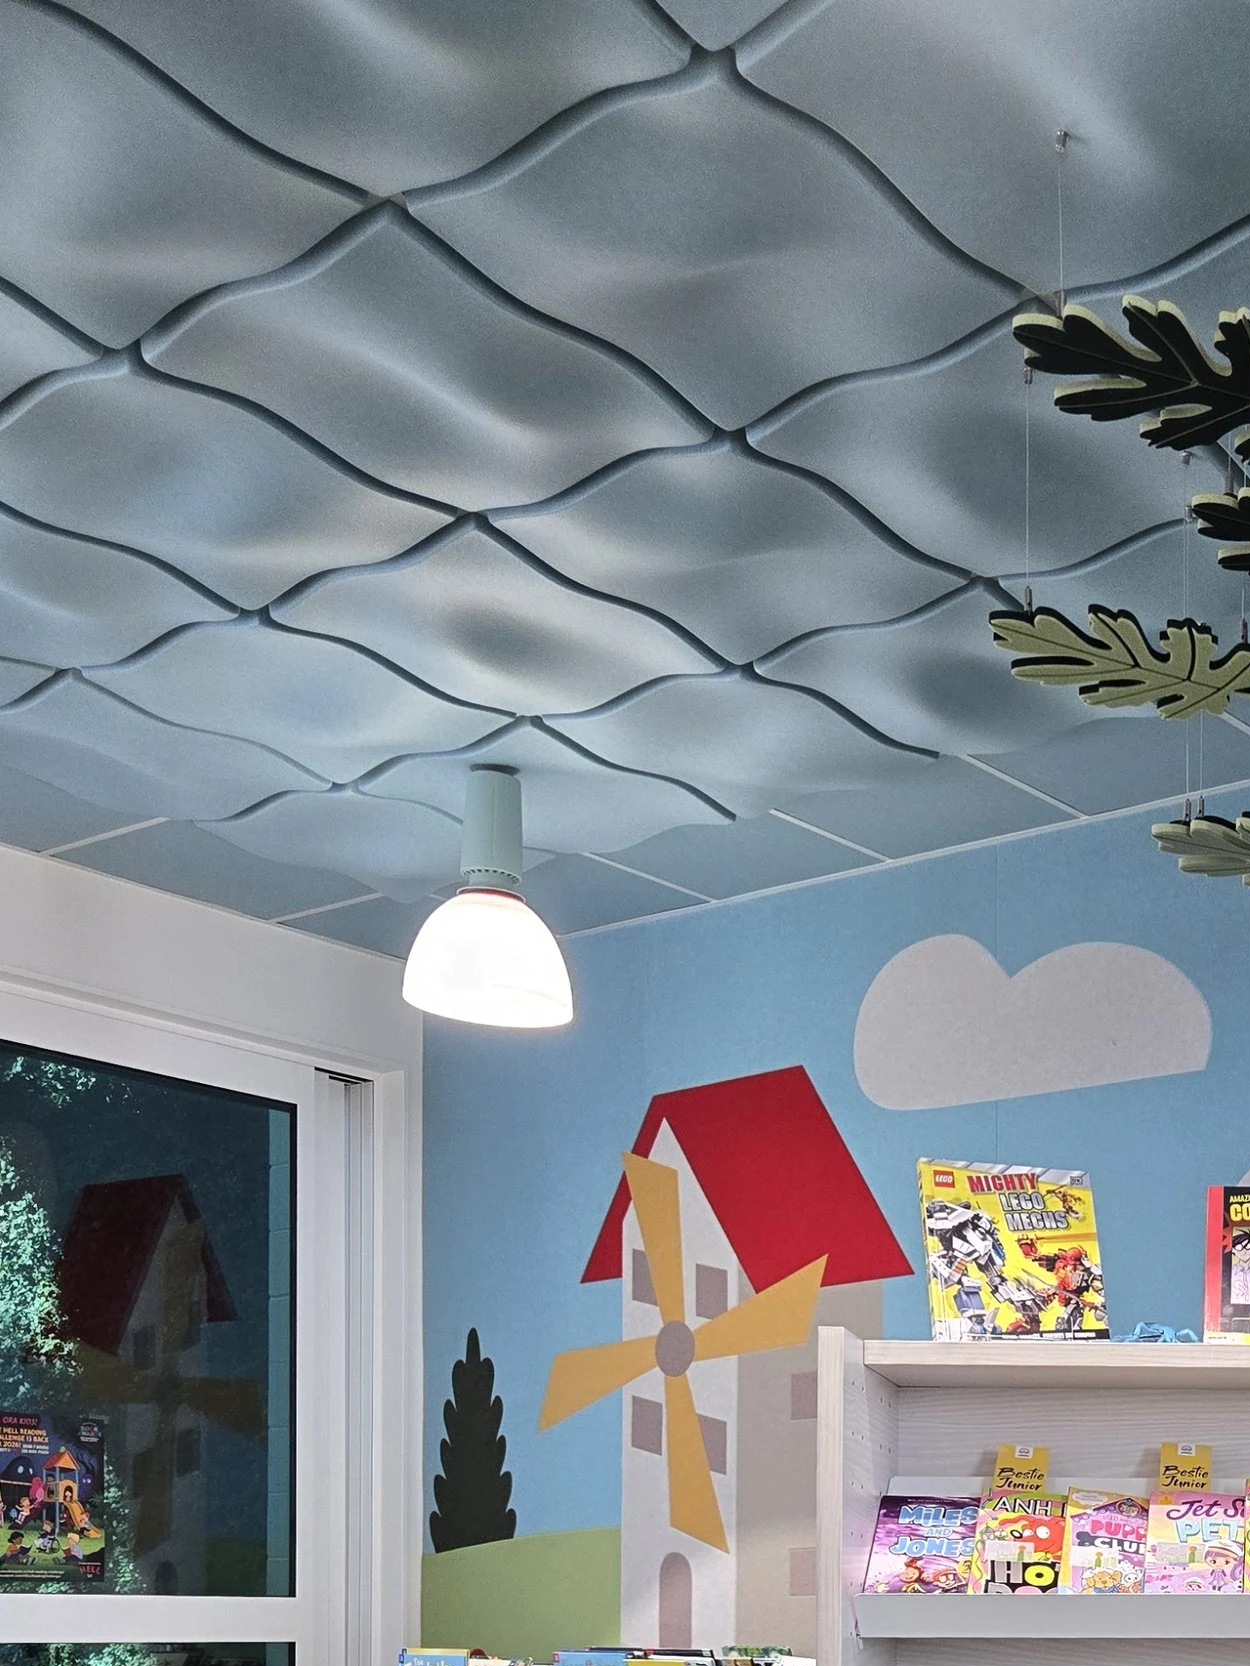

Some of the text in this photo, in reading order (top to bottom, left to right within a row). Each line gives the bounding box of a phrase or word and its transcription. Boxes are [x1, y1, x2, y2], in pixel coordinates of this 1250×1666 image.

[935, 1174, 953, 1183] LEGO
[967, 1173, 1038, 1193] MIGHTY
[999, 1192, 1045, 1212] LEGO
[1005, 1212, 1069, 1232] MECHS
[20, 1428, 47, 1437] READING
[997, 1467, 1045, 1481] Bestie
[1162, 1465, 1209, 1479] Bestie
[996, 1477, 1043, 1492] Junior
[1162, 1476, 1208, 1489] Junior
[993, 1496, 1052, 1516] ANH
[1166, 1499, 1222, 1520] Jet
[926, 1527, 953, 1538] AND
[888, 1536, 975, 1558] JONES
[413, 1657, 424, 1666] The
